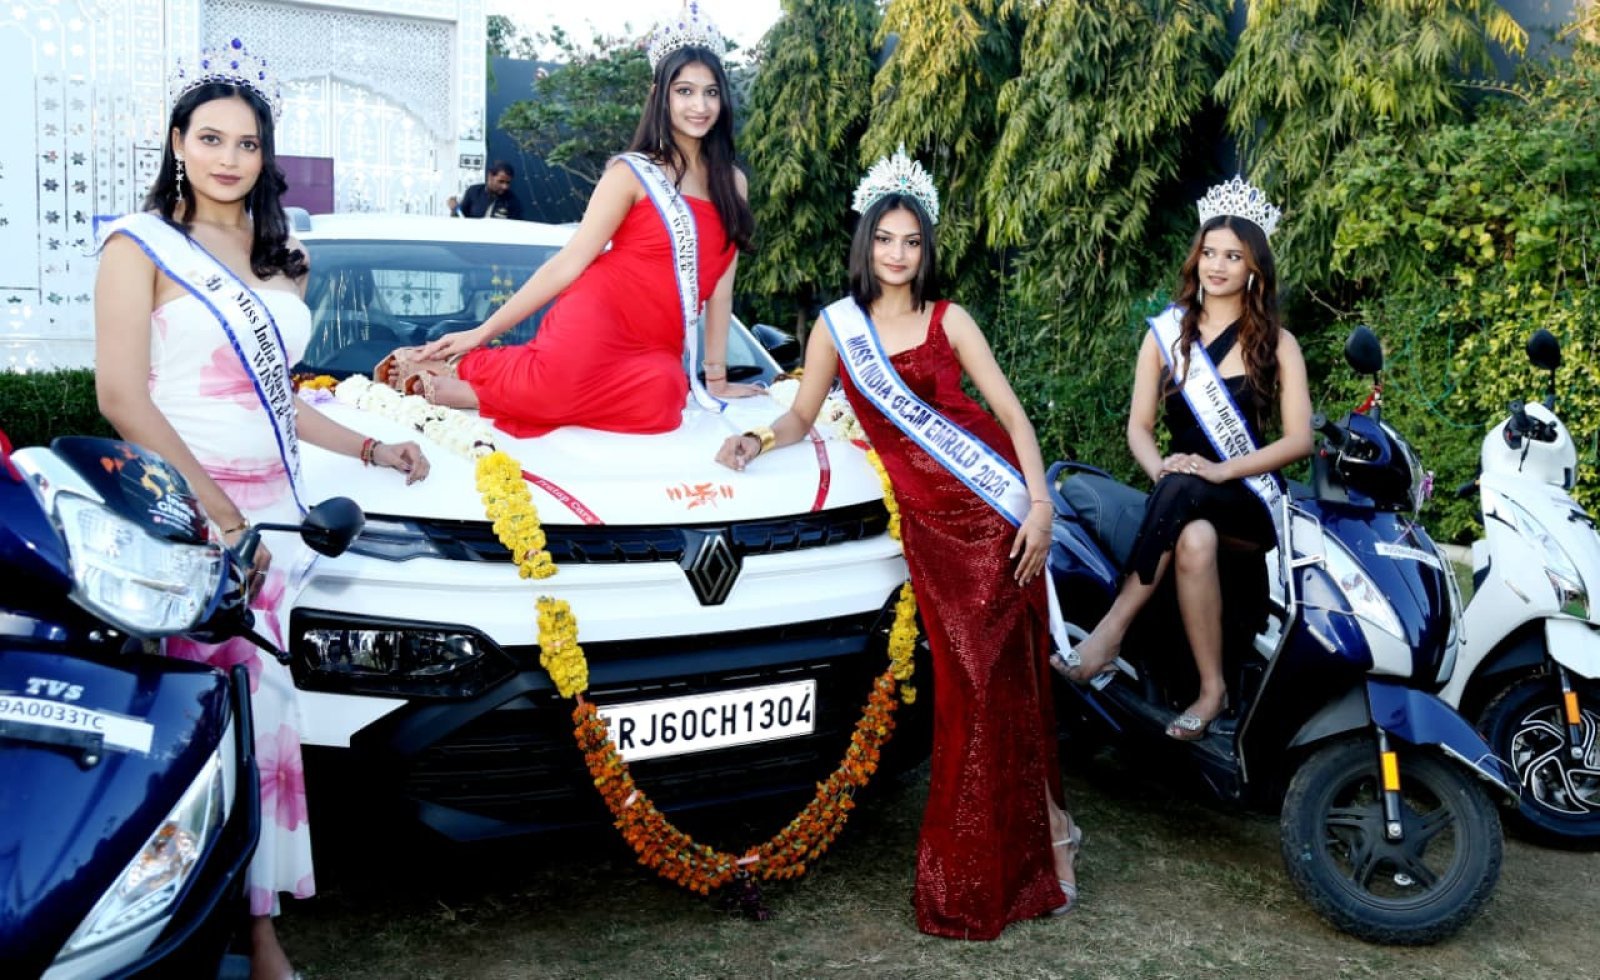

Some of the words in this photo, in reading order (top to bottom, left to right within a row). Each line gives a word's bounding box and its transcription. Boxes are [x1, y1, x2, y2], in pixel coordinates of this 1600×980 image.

[672, 217, 688, 271] WINNER
[233, 291, 259, 325] Miss
[253, 323, 277, 364] India
[272, 363, 288, 403] Glam
[847, 334, 873, 368] MISS
[252, 351, 287, 420] WINNER
[859, 362, 895, 400] INDIA
[890, 394, 932, 432] GLAM
[1204, 380, 1221, 407] Miss
[1217, 404, 1241, 436] India
[924, 418, 980, 471] EMRALD
[1214, 422, 1241, 460] WINNE
[970, 463, 1012, 499] 2026
[25, 677, 85, 701] TVS
[618, 692, 811, 750] RJ60CH1304
